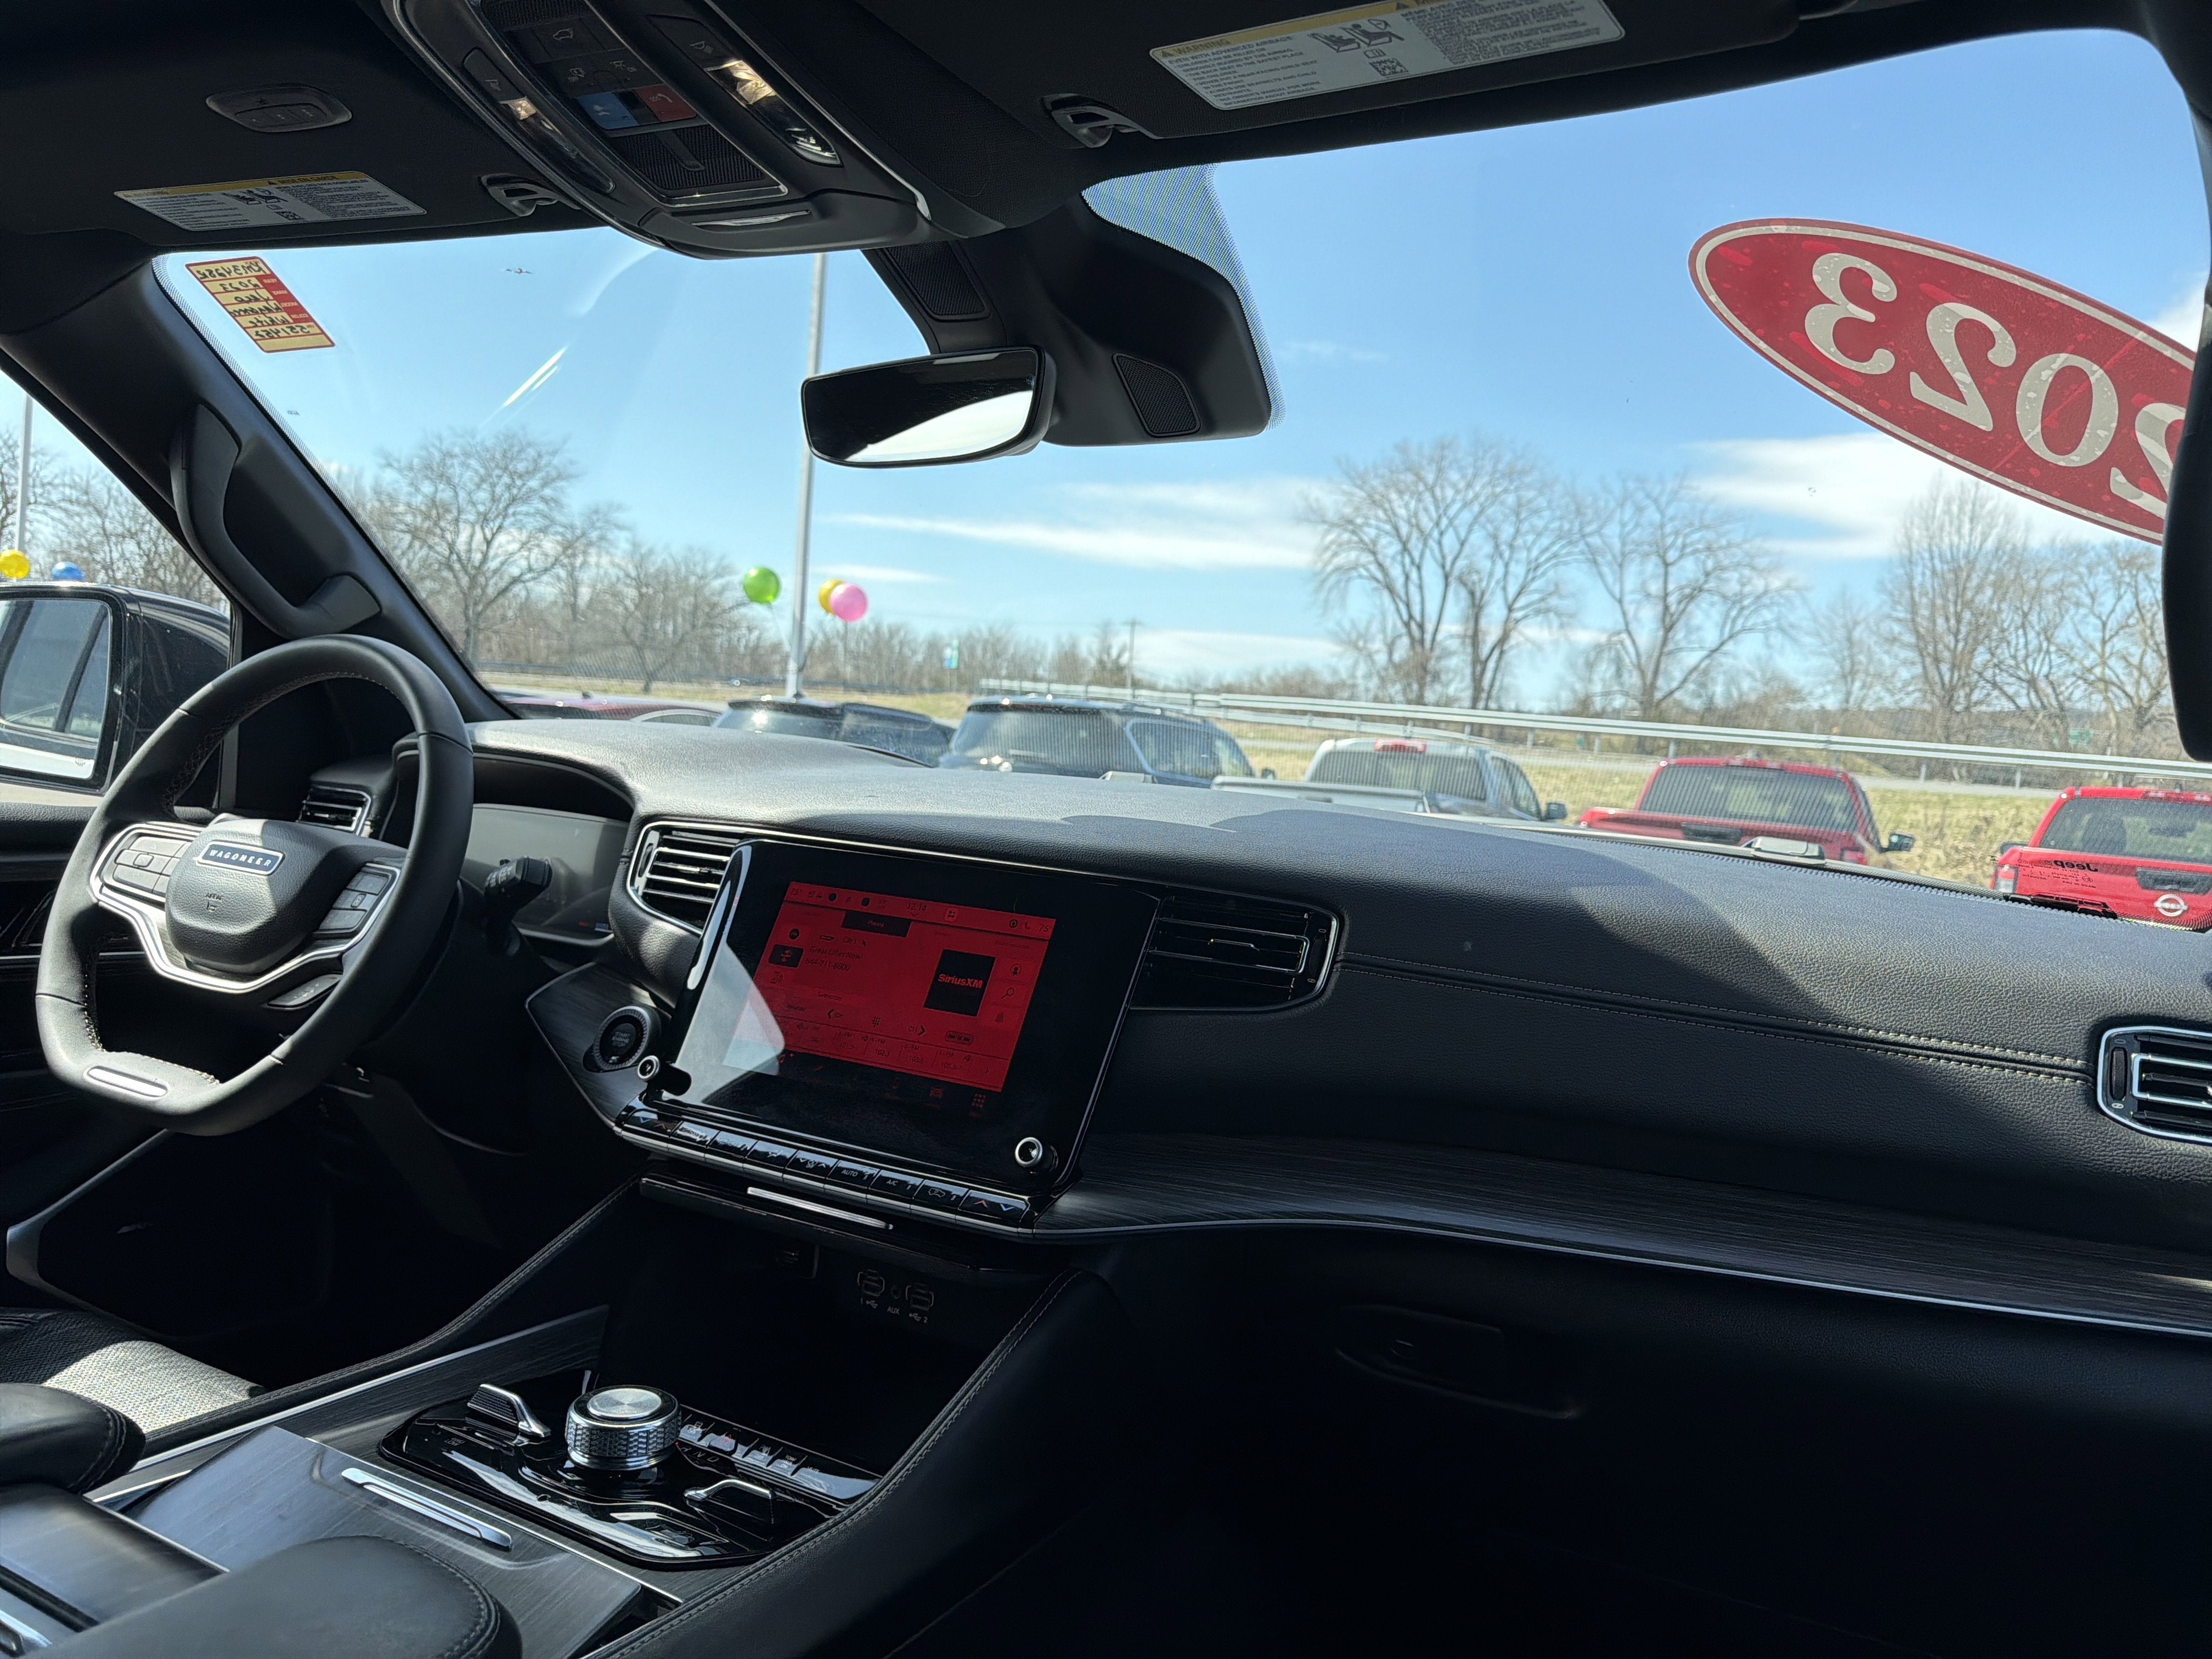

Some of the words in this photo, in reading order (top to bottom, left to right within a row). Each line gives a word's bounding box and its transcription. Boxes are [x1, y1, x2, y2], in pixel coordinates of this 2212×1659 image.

[1173, 38, 1231, 54] WARNING
[1211, 43, 1253, 55] ADVANCED
[1255, 36, 1291, 47] AIRBAGS
[1177, 59, 1207, 67] CHILDREN
[208, 850, 272, 867] WAGONEER
[938, 973, 983, 988] SiriusXM
[840, 1169, 858, 1177] AUTO
[886, 1178, 899, 1187] A/C
[887, 1305, 900, 1315] AUX
